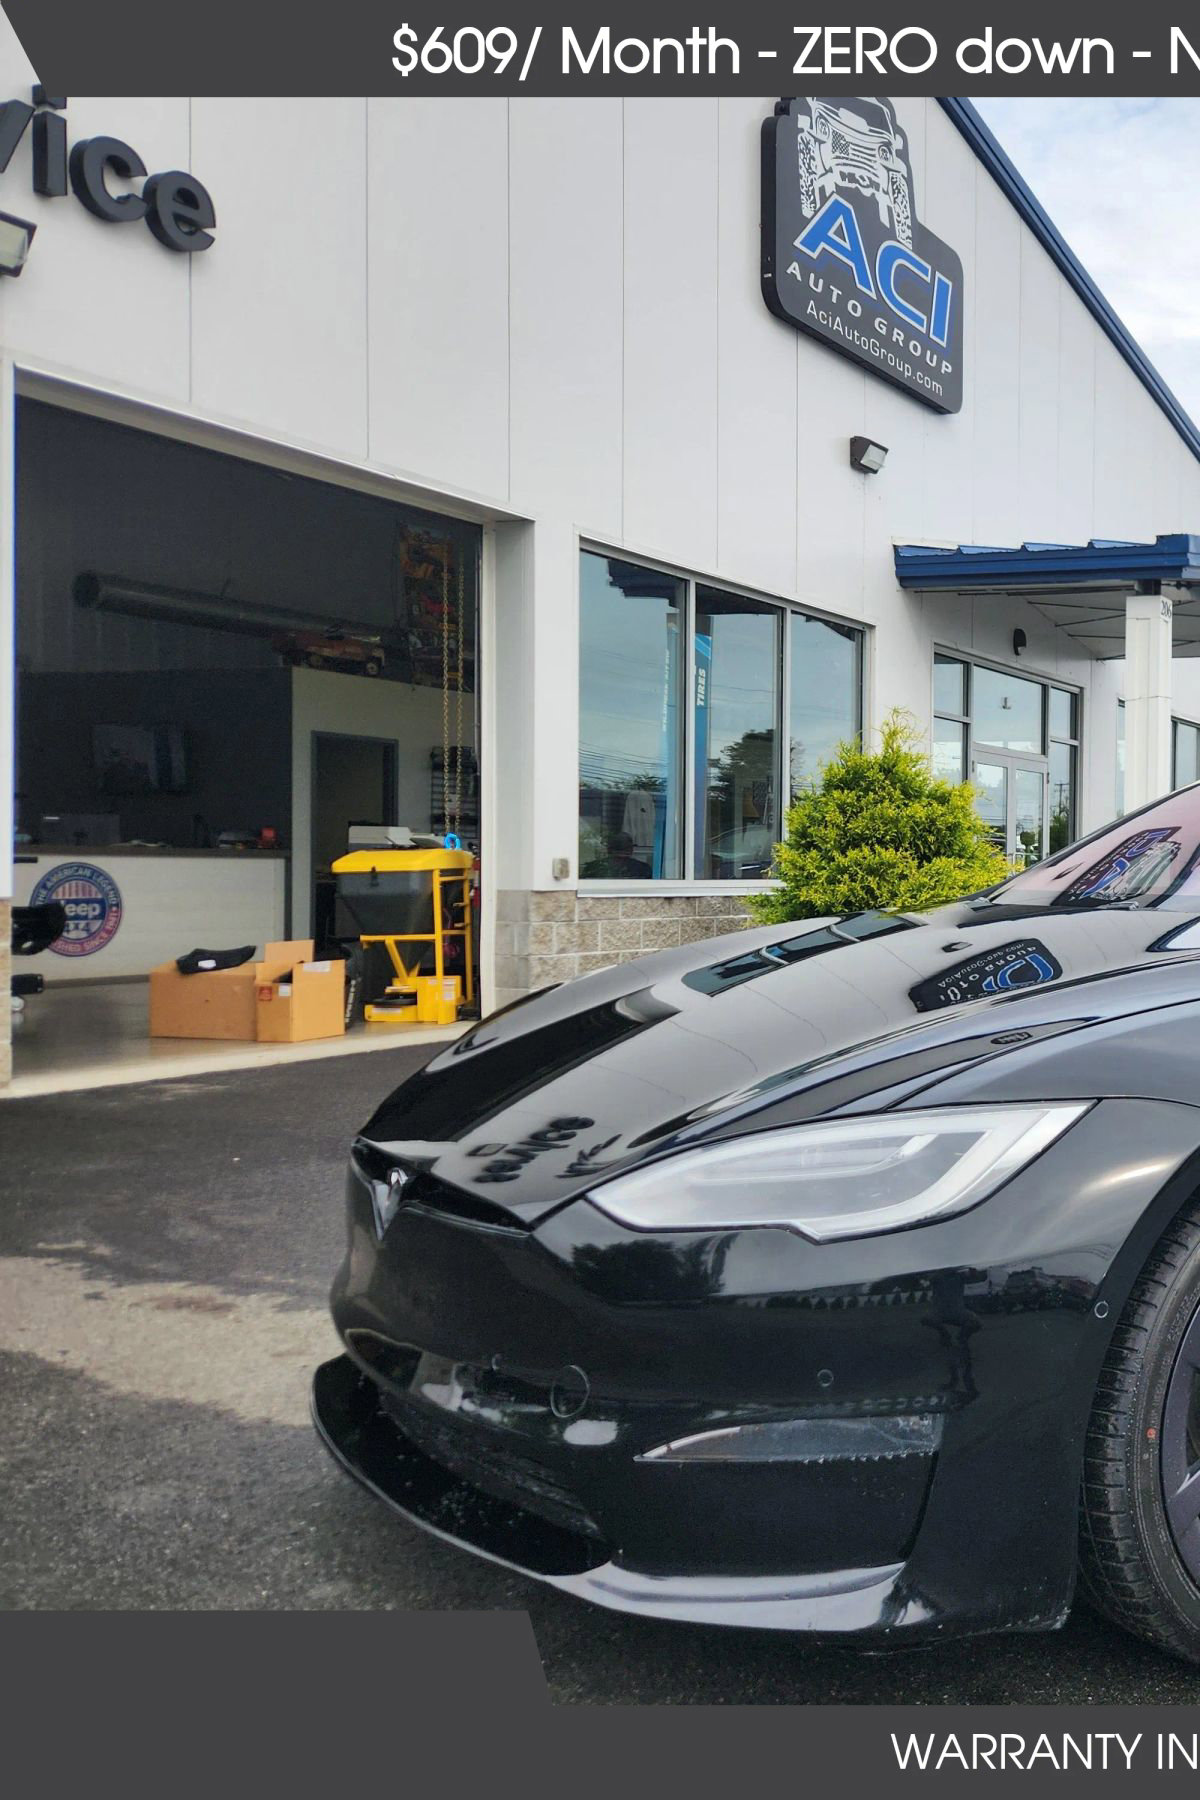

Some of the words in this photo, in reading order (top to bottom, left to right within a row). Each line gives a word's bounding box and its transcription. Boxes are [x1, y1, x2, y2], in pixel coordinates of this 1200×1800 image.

[786, 260, 862, 318] AUTO
[874, 316, 953, 375] GROUP
[793, 191, 953, 349] ACI
[806, 299, 943, 397] AciAutoGroup.com
[696, 667, 706, 706] TIRES
[61, 900, 101, 919] eep
